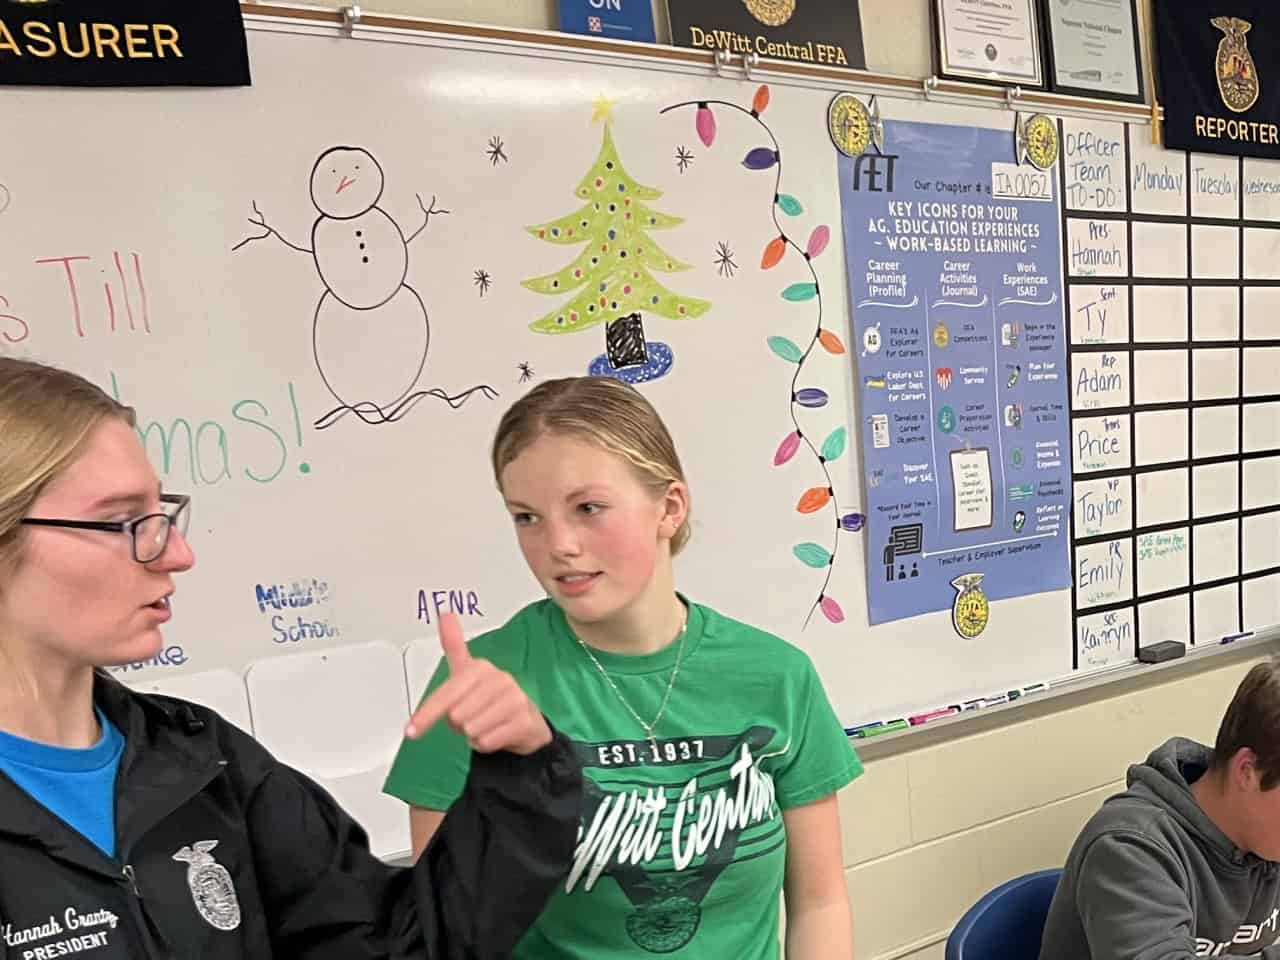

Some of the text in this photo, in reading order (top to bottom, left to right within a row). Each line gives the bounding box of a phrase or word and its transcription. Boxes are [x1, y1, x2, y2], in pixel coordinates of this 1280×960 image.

[690, 26, 849, 66] DeWitt Central FFA
[1195, 115, 1280, 145] REPORTER
[1066, 132, 1120, 159] Officer
[1070, 160, 1111, 185] Team
[1134, 162, 1183, 193] Monday
[888, 201, 1018, 220] KEY ICONS FOR YOUR
[869, 218, 1040, 237] AG. EDUCATION EXPERIENCES
[886, 236, 1027, 253] WORK-BASED LEARNING
[1073, 240, 1121, 268] Hannah
[868, 259, 900, 270] Career
[940, 272, 977, 284] Activities
[944, 261, 970, 271] Career
[1017, 263, 1036, 274] Work
[866, 272, 907, 285] Planning
[1003, 275, 1048, 286] Experiences
[34, 250, 151, 338] Till
[1077, 302, 1106, 337] Ty
[1076, 367, 1122, 397] Adam
[1078, 429, 1121, 461] Price
[1078, 490, 1122, 525] Taylor
[1079, 556, 1124, 592] Emily
[417, 588, 485, 624] AFNR
[598, 740, 705, 765] EST. 1937
